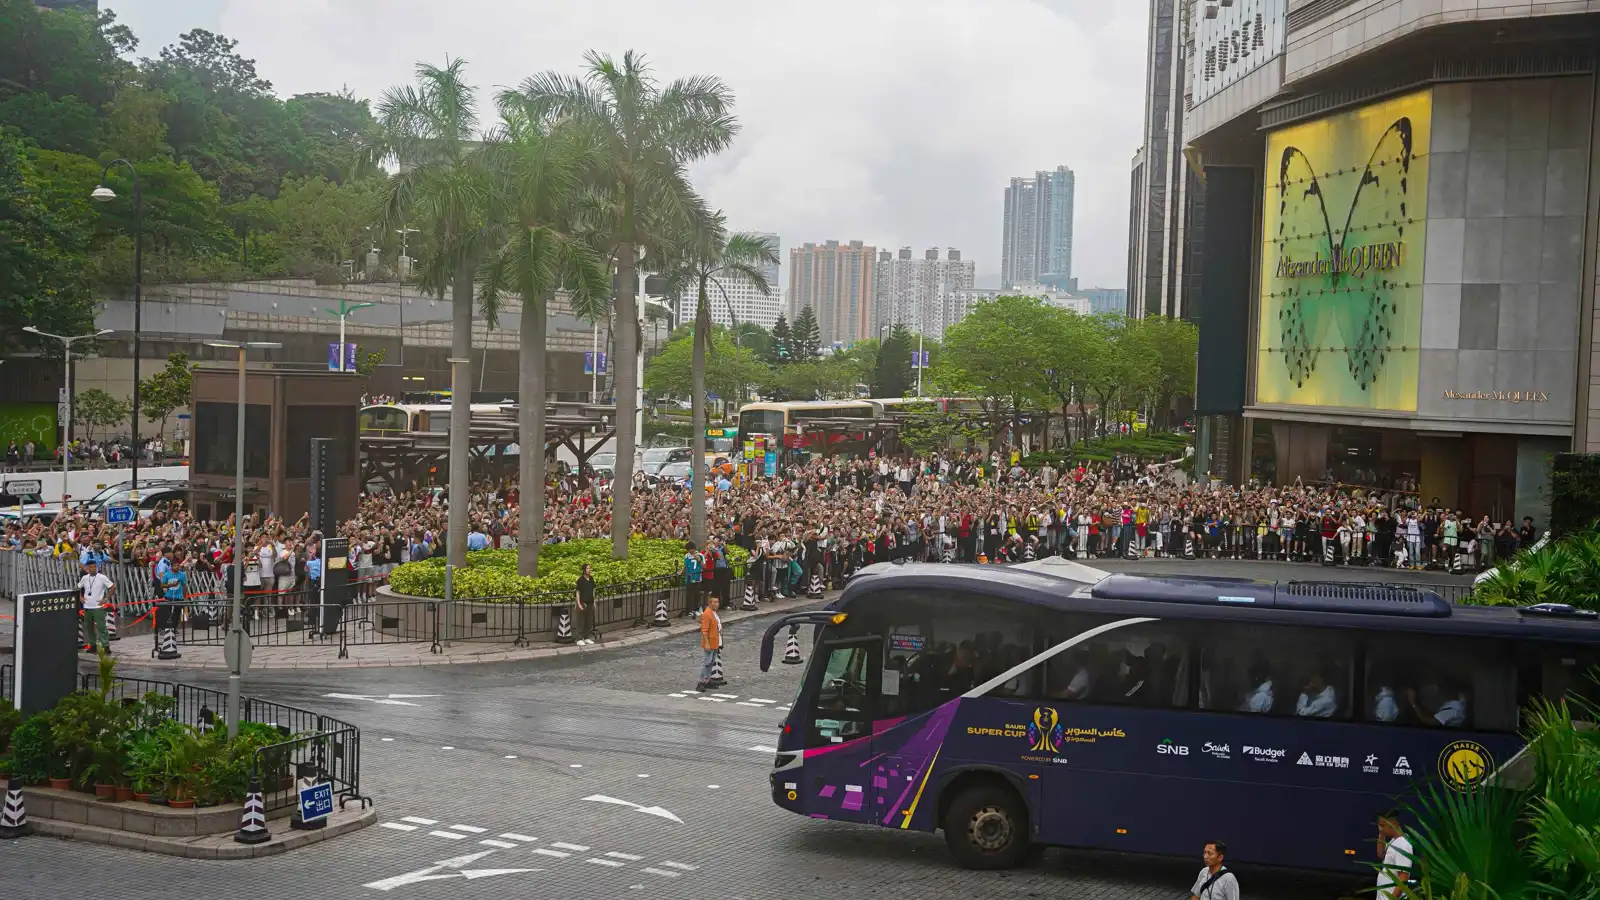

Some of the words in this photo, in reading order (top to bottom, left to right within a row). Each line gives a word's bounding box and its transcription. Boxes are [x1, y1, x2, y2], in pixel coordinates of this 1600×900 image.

[1204, 13, 1264, 81] MUSEA
[1275, 251, 1330, 278] Alexander
[1331, 242, 1402, 278] McQUEEN
[1443, 389, 1490, 400] Alexander
[1492, 391, 1549, 404] McQUEEN
[691, 560, 697, 570] 7
[30, 596, 76, 606] VICTORIA
[30, 603, 76, 613] DOCKSIDE
[967, 727, 1002, 736] SUPER
[1004, 730, 1026, 738] CUP
[1156, 744, 1190, 756] SNB
[1254, 746, 1285, 758] Budget
[1453, 743, 1480, 752] NASSR
[315, 788, 329, 799] EXIT
[316, 798, 330, 811] 出口
